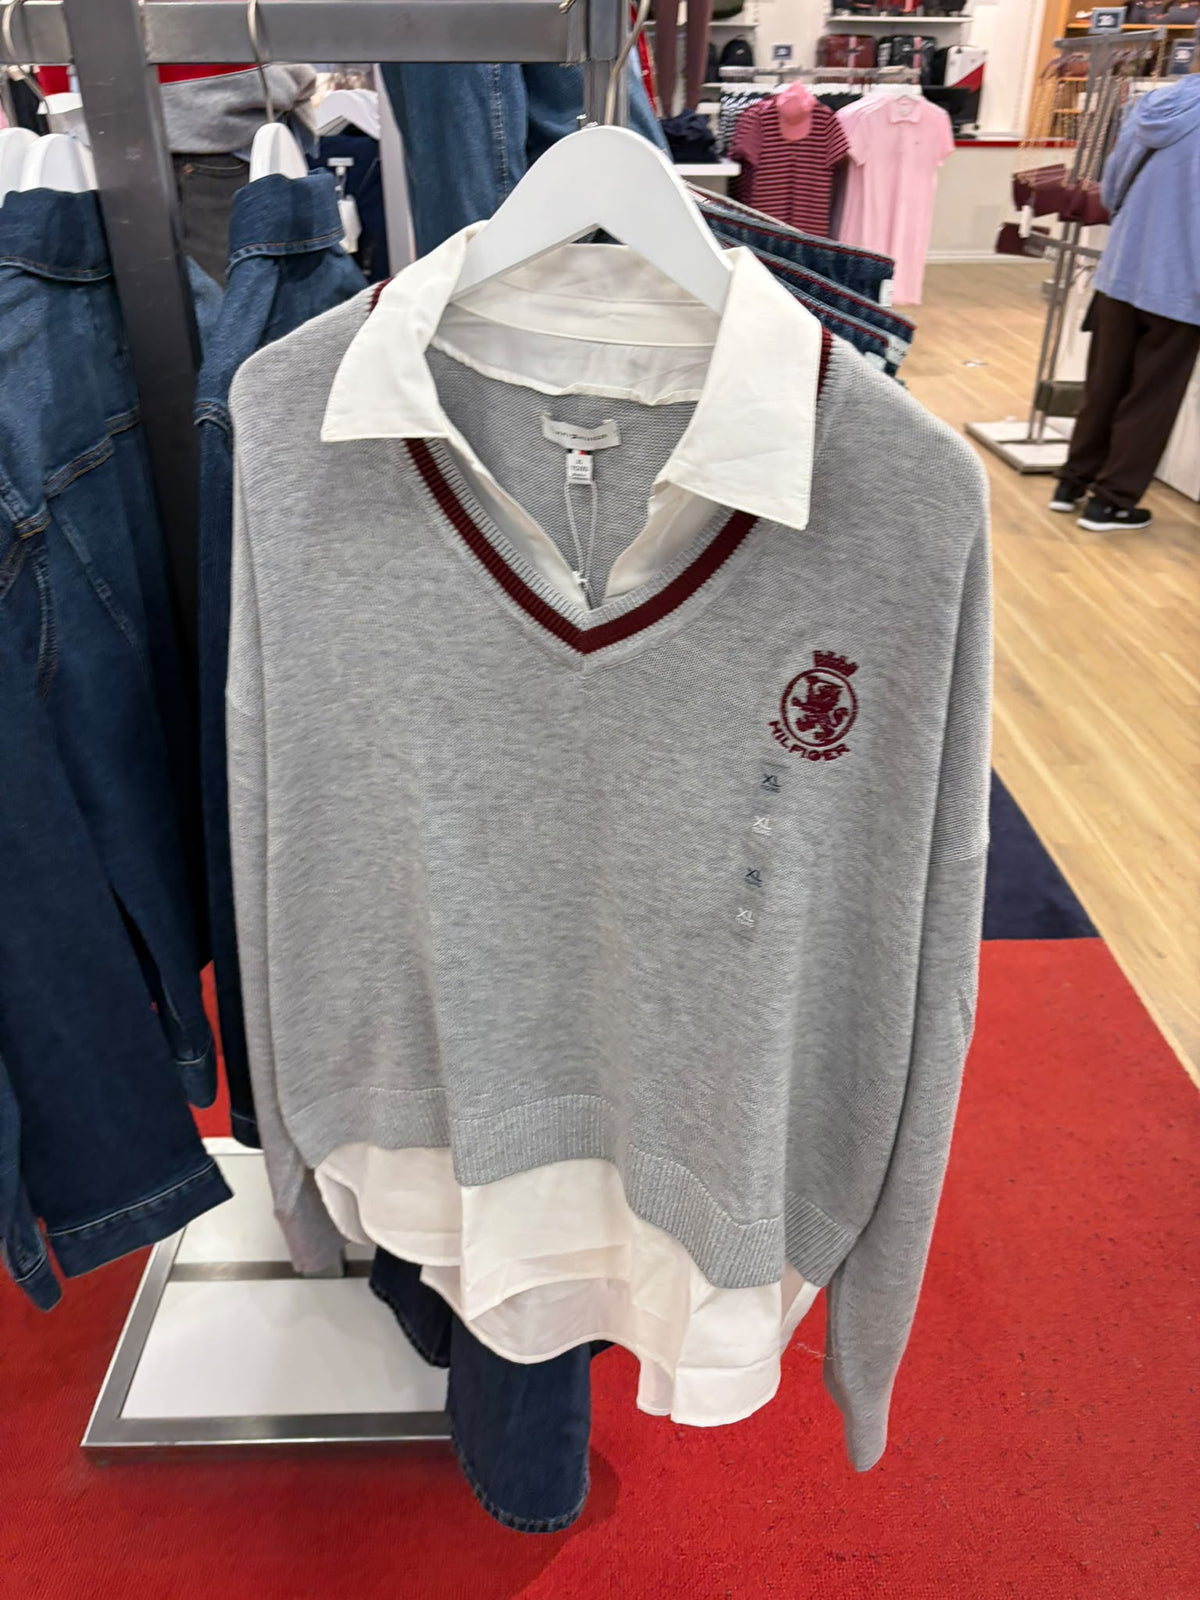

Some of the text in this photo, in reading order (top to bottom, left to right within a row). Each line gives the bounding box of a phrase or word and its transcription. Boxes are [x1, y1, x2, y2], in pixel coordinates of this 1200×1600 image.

[768, 721, 851, 761] HILFIGER
[762, 774, 781, 787] XL
[753, 816, 772, 829] XL
[745, 867, 762, 882] XL
[737, 908, 755, 922] XL
